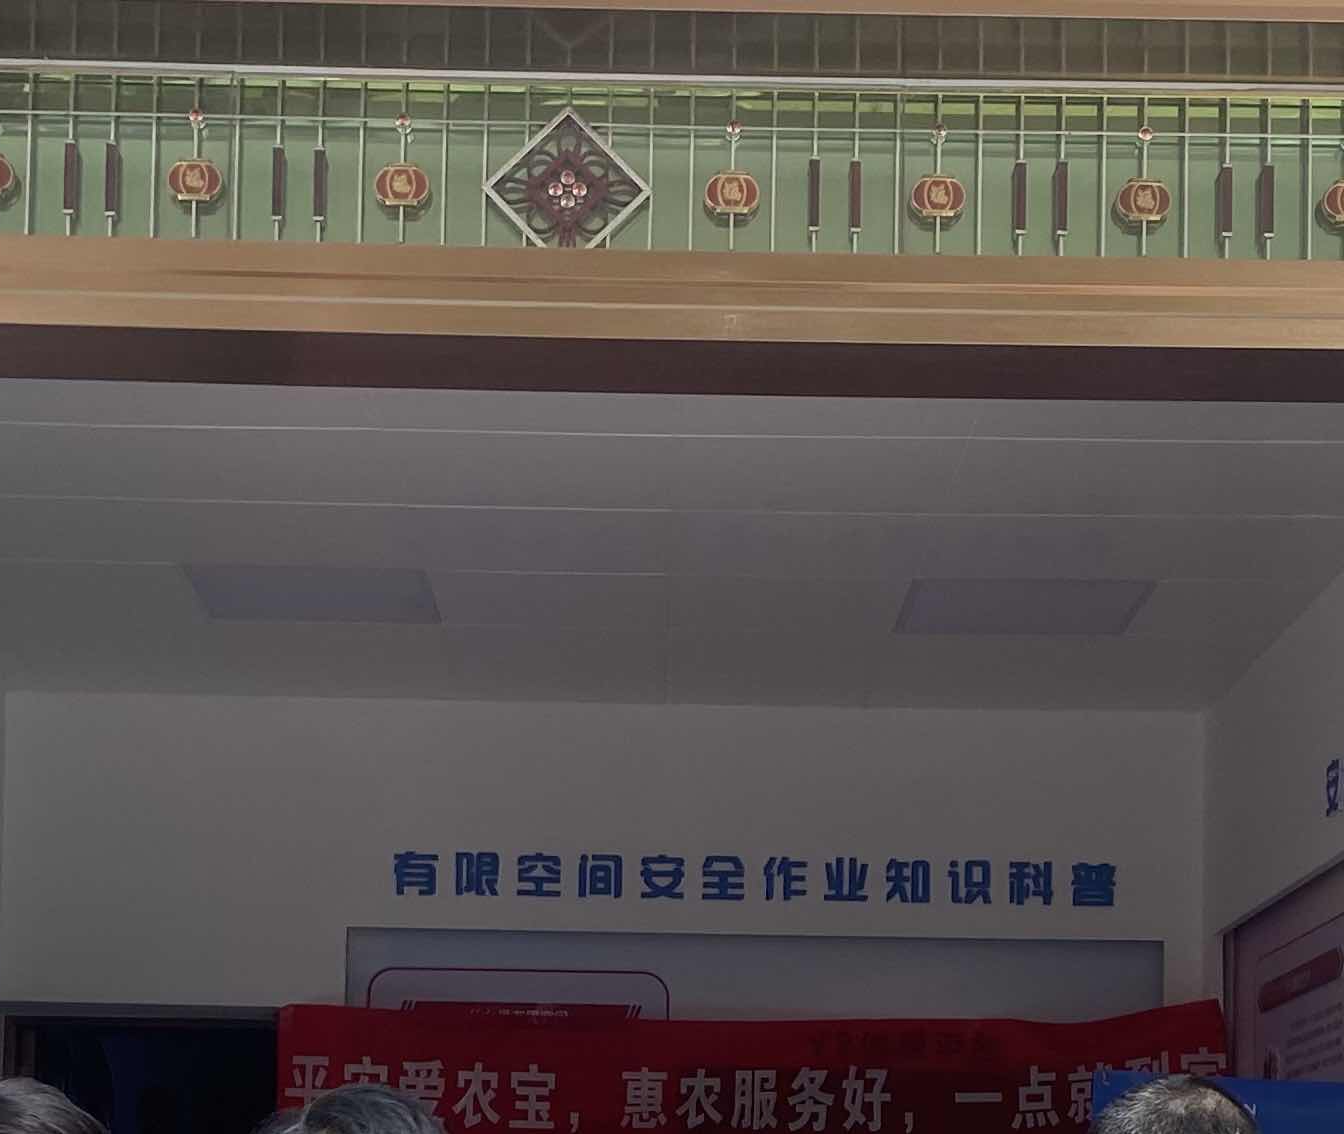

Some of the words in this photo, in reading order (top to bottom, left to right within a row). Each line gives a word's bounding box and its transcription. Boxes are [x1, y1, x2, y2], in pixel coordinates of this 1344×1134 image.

[393, 850, 1117, 907] 有限空间安全作业知识科普
